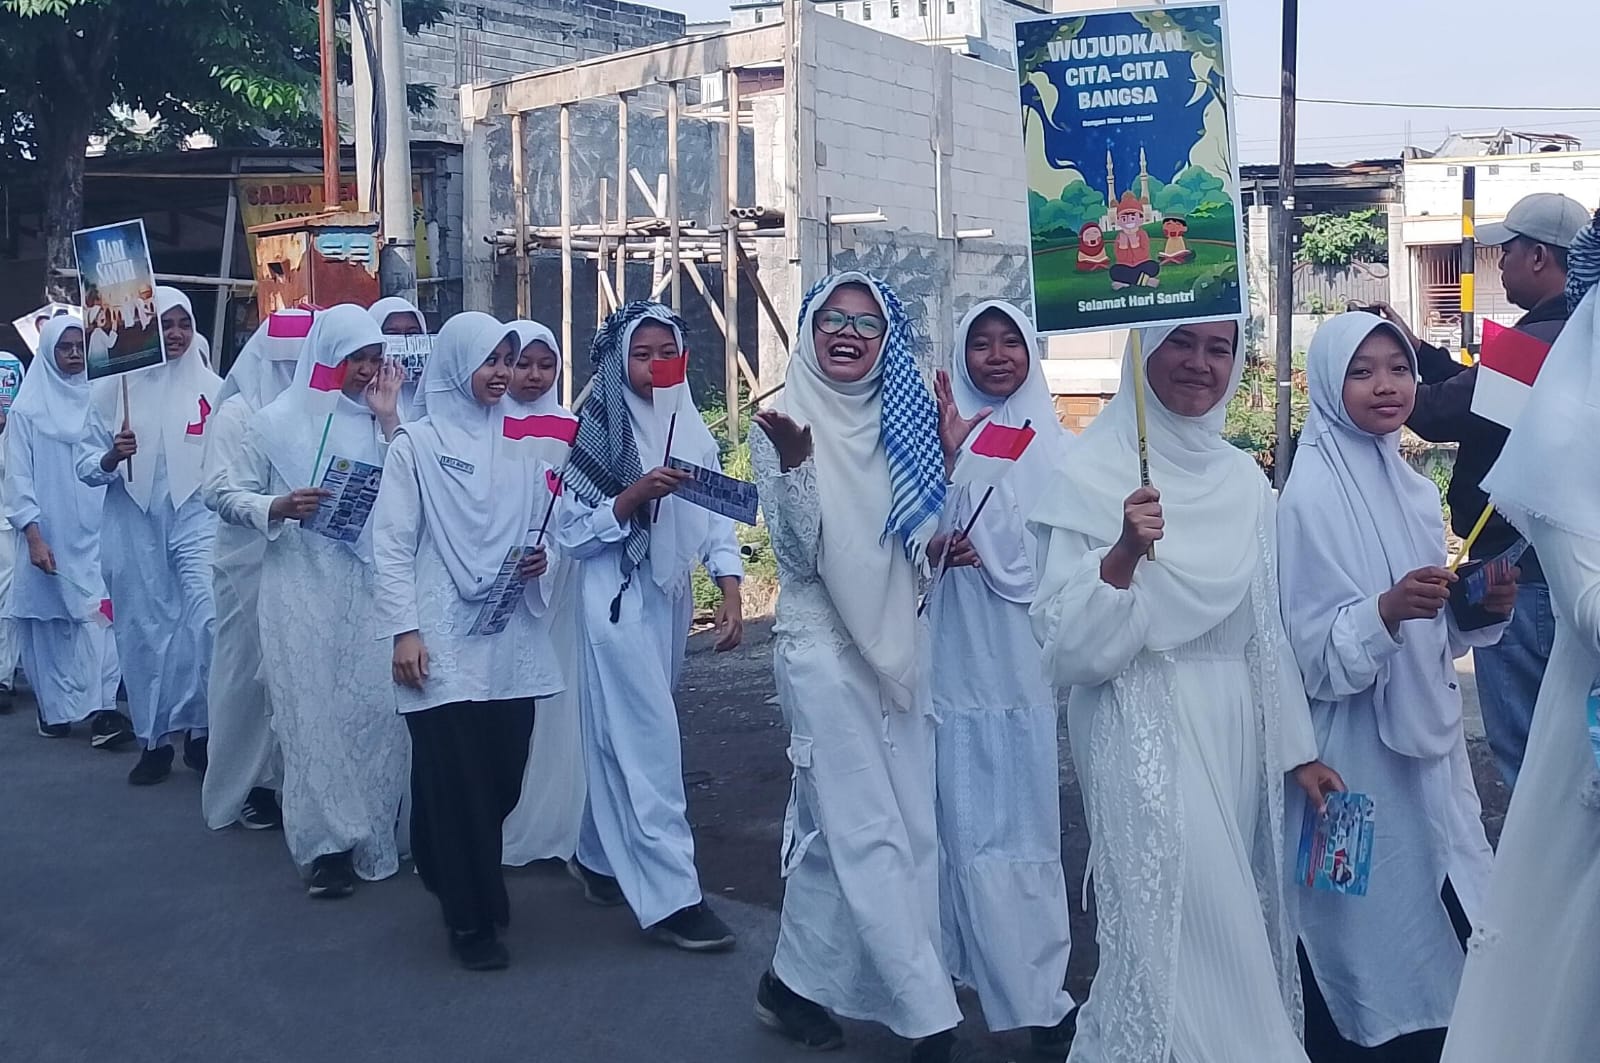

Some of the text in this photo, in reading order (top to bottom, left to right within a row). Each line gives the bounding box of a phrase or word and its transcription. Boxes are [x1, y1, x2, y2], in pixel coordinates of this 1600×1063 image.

[1047, 30, 1183, 62] WUJUDKAN
[1065, 60, 1169, 87] CITA-CITA
[1078, 86, 1158, 110] BANGSA
[247, 184, 312, 206] SABAR
[1078, 289, 1195, 312] Selamat Hari Santri
